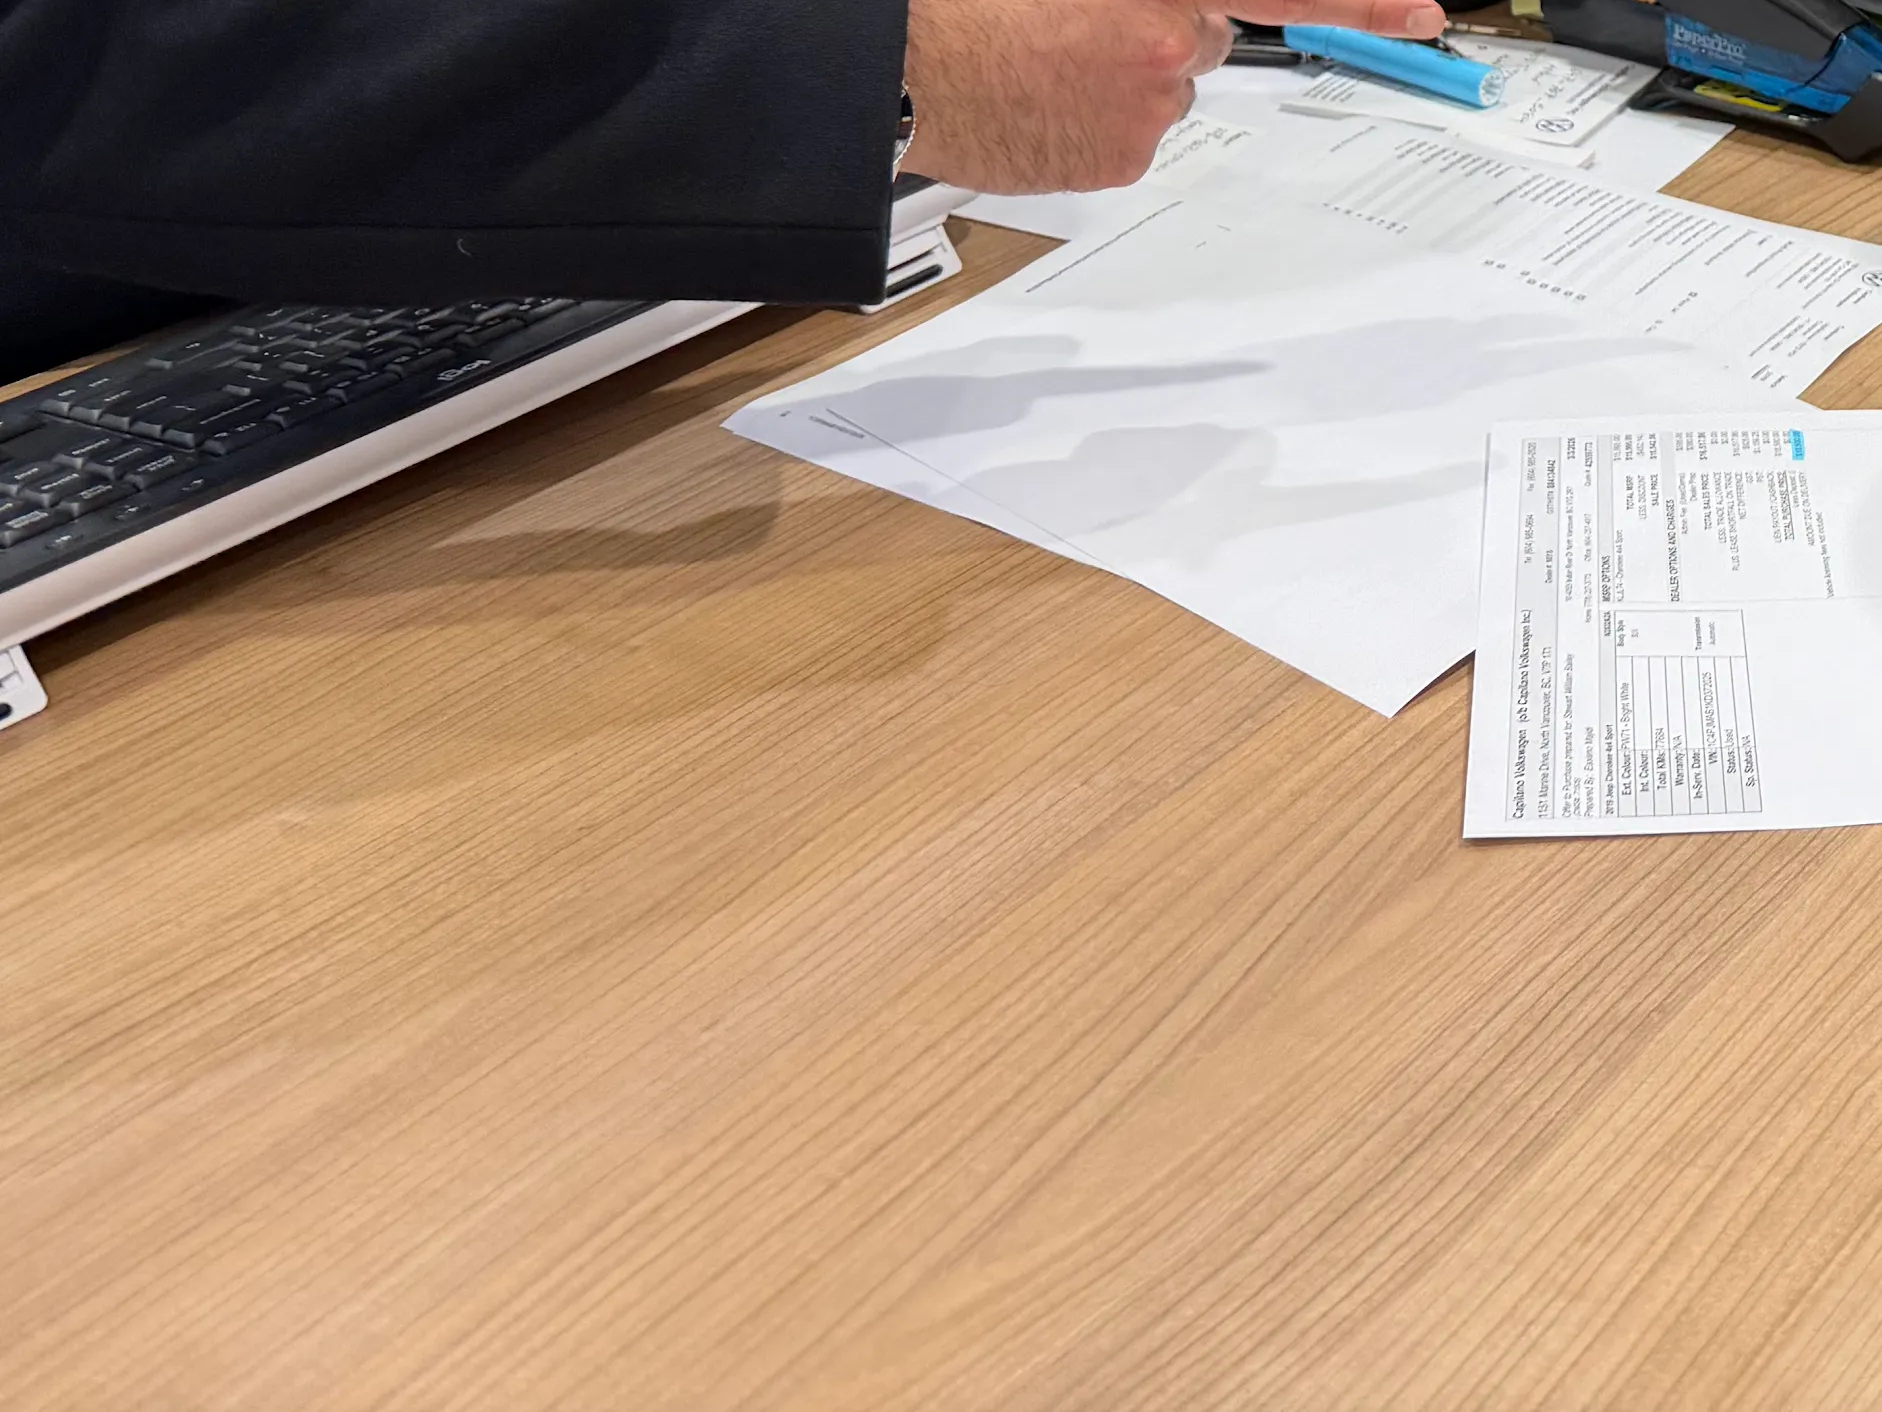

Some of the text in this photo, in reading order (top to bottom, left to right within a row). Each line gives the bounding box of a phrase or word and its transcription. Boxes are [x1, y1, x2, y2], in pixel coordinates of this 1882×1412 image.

[1672, 22, 1744, 55] PaperPro
[437, 360, 492, 381] logi
[1638, 475, 1646, 502] DISCOUNT
[1713, 472, 1724, 504] ALLOWANCE
[1724, 472, 1734, 489] TRADE
[1735, 472, 1745, 506] DIFFERENCE
[1626, 491, 1634, 510] TOTAL
[1702, 490, 1711, 509] SALES
[1726, 490, 1734, 499] ON
[1781, 489, 1792, 520] PURCHASE
[1704, 510, 1713, 530] TOTAL
[1716, 505, 1725, 525] TRADE
[1727, 500, 1737, 533] SHORTFALL
[1771, 505, 1780, 526] PAYOUT
[1799, 471, 1815, 546] AMOUNT DUE ON DELIVERY
[1785, 521, 1793, 540] TOTAL
[1667, 499, 1680, 601] DEALER OPTIONS AND CHARGES
[1729, 534, 1739, 553] LEASE
[1602, 555, 1610, 582] OPTIONS
[1602, 584, 1610, 602] MSRP
[1617, 634, 1625, 646] Body
[1694, 616, 1702, 650] Transmission
[1519, 625, 1532, 669] Volkswagen
[1517, 671, 1530, 705] Capilano
[1621, 682, 1629, 701] White
[1620, 703, 1632, 722] Bright
[1540, 730, 1549, 749] North
[1605, 724, 1613, 740] Sport
[1564, 732, 1575, 759] prepared
[1709, 749, 1718, 764] VIN:
[1724, 729, 1736, 773] Status: Used
[1622, 751, 1631, 778] Colour:
[1640, 751, 1648, 778] Colour:
[1657, 750, 1666, 790] Total KMs:
[1675, 750, 1684, 786] Warranty:
[1692, 750, 1701, 768] Date:
[1745, 748, 1753, 773] Status:
[1512, 730, 1529, 819] Capilano Volkswagen
[1539, 773, 1549, 797] Marine
[1562, 761, 1572, 791] Purchase
[1606, 784, 1614, 798] Jeep
[1622, 782, 1631, 795] Ext.
[1562, 800, 1572, 818] Offer
[1584, 786, 1595, 817] Prepared
